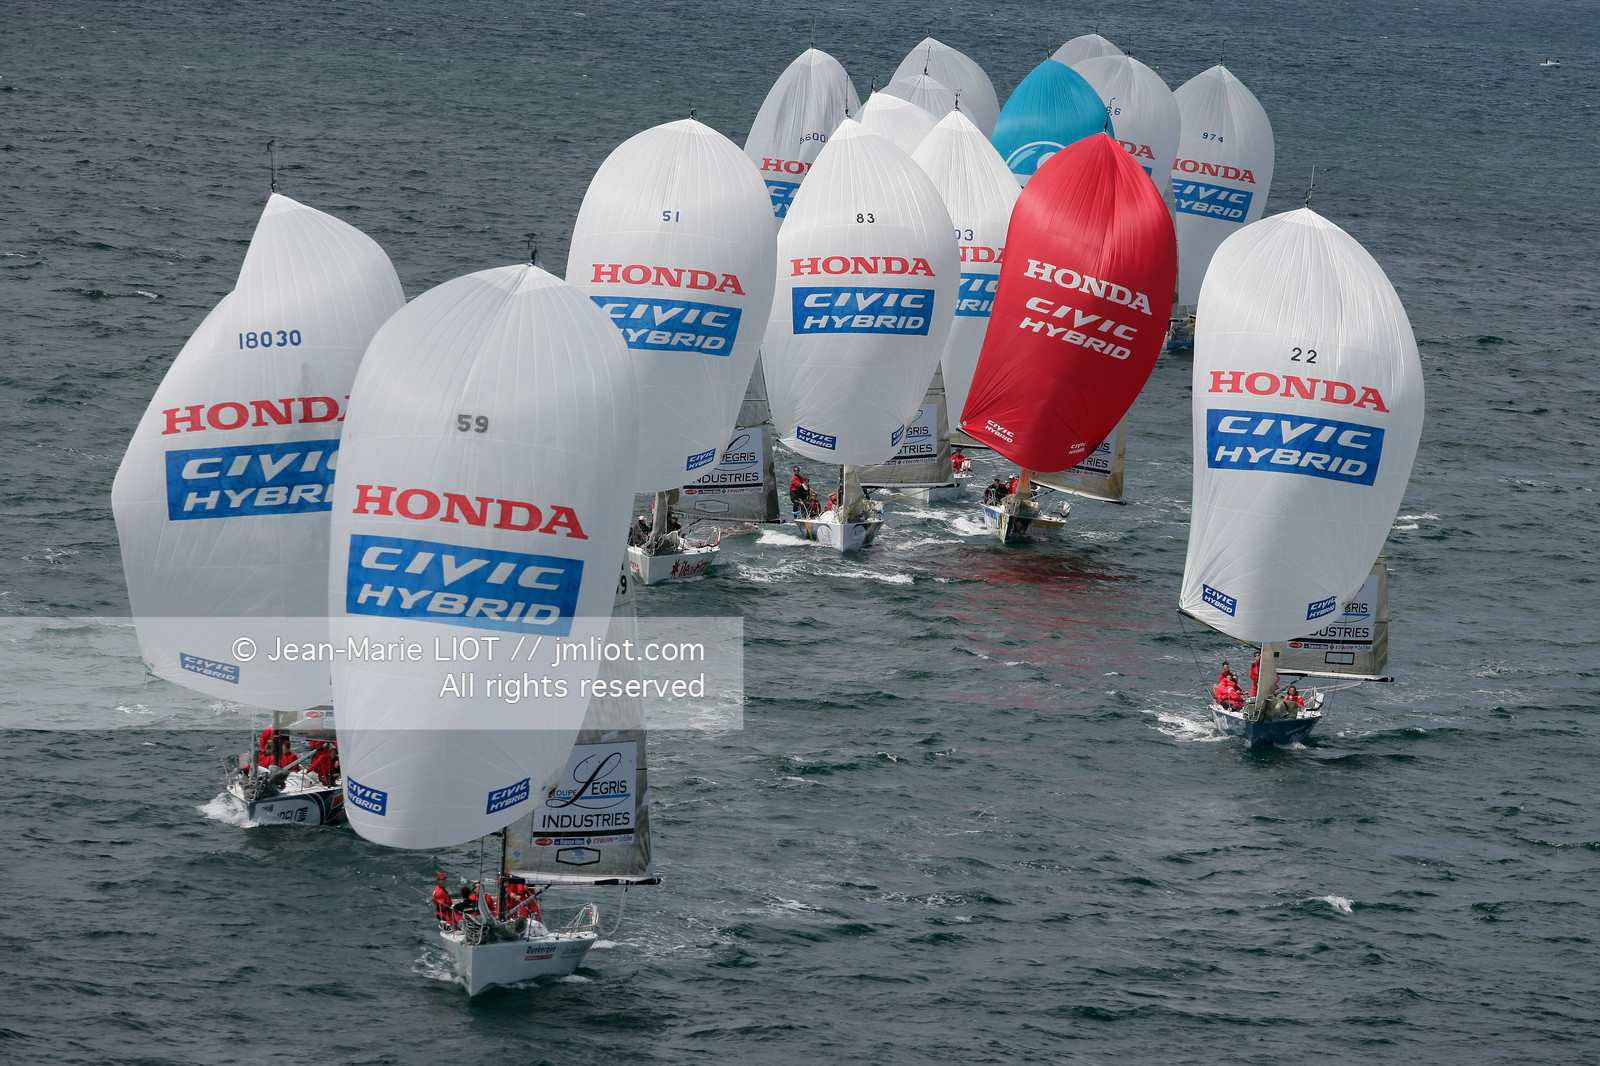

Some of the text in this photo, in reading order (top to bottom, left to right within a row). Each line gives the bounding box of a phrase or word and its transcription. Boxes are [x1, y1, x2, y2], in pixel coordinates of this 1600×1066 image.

[1202, 132, 1224, 143] 974
[1115, 140, 1155, 160] DA
[662, 210, 680, 222] 51
[856, 213, 875, 224] 83
[1175, 198, 1243, 219] YBRID
[790, 256, 936, 277] HONDA
[590, 263, 746, 296] HONDA
[1023, 258, 1152, 316] HONDA
[803, 292, 926, 312] CIVIC
[602, 303, 731, 328] CIVIC
[803, 314, 925, 329] HYBRID
[1025, 296, 1139, 341] CIVIC
[239, 329, 302, 350] 18030
[620, 328, 726, 350] YBRID
[1019, 316, 1131, 360] HYBRID
[1290, 347, 1317, 364] 22
[1208, 370, 1390, 414] HONDA
[457, 414, 489, 433] 59
[987, 419, 1015, 438] CIVIC
[1217, 415, 1372, 450] CIVIC
[798, 435, 833, 449] HYBRID
[799, 428, 834, 443] CIVIC
[1214, 445, 1368, 477] HYBRID
[692, 472, 759, 484] DUSTRIES
[352, 484, 589, 540] HONDA
[361, 546, 565, 591] CIVIC
[357, 583, 561, 626] HYBRID
[1204, 586, 1235, 606] CIVIC
[1204, 595, 1233, 614] HYBRID
[184, 656, 236, 673] CIVIC
[184, 663, 236, 680] HYBRID
[348, 779, 384, 802] CIVIC
[491, 781, 527, 801] CIVIC
[553, 789, 578, 797] OUPE
[490, 791, 527, 812] HYBRID
[542, 811, 631, 829] INDUSTRIES
